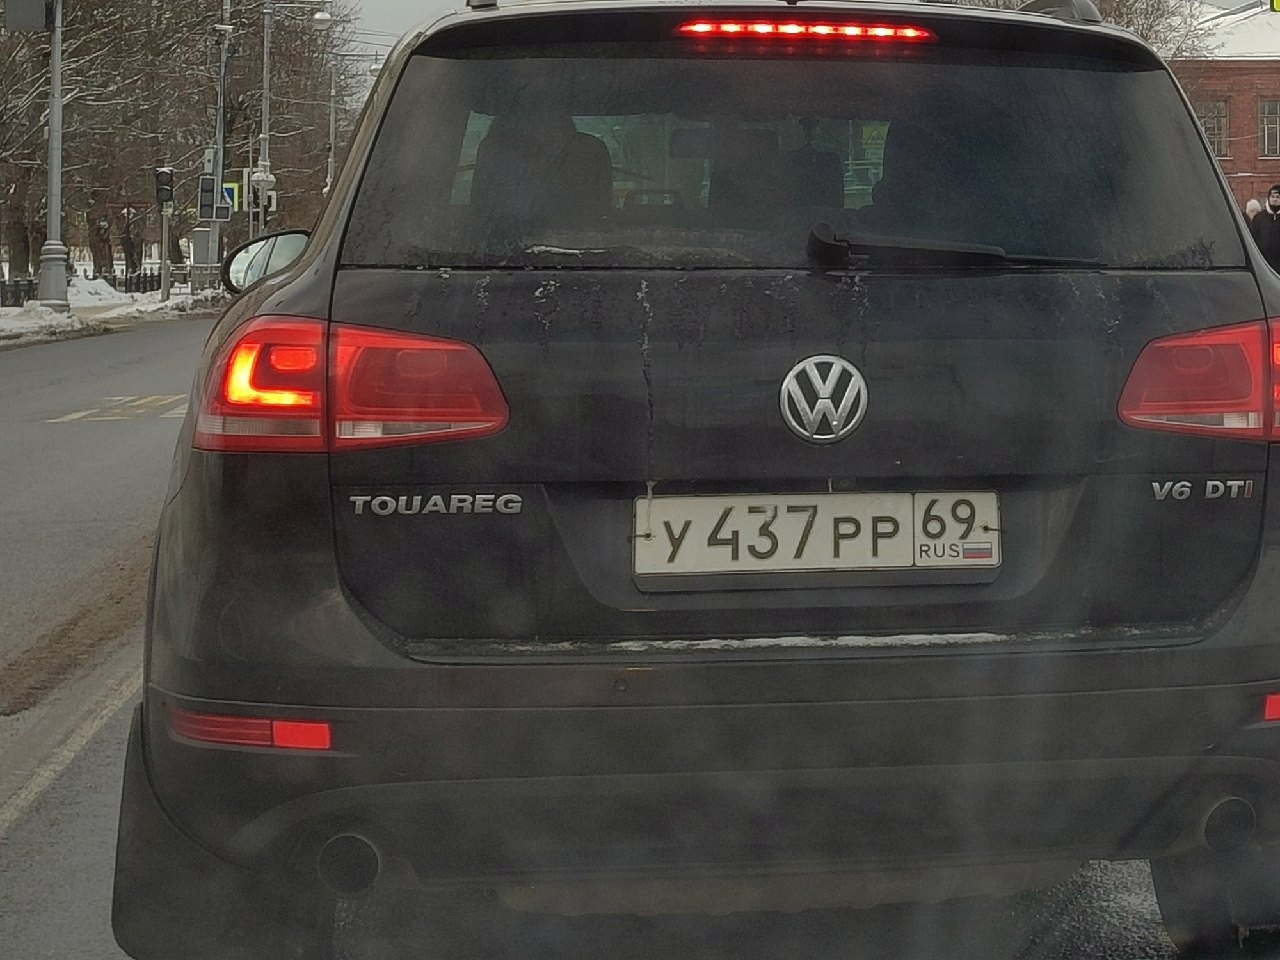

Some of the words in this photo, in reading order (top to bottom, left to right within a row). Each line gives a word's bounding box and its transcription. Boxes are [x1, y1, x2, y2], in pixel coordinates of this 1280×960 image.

[1151, 481, 1192, 500] V6
[1204, 480, 1253, 499] DTI
[349, 494, 523, 516] TOUAREG
[922, 499, 976, 540] 69
[919, 544, 960, 559] RUS
